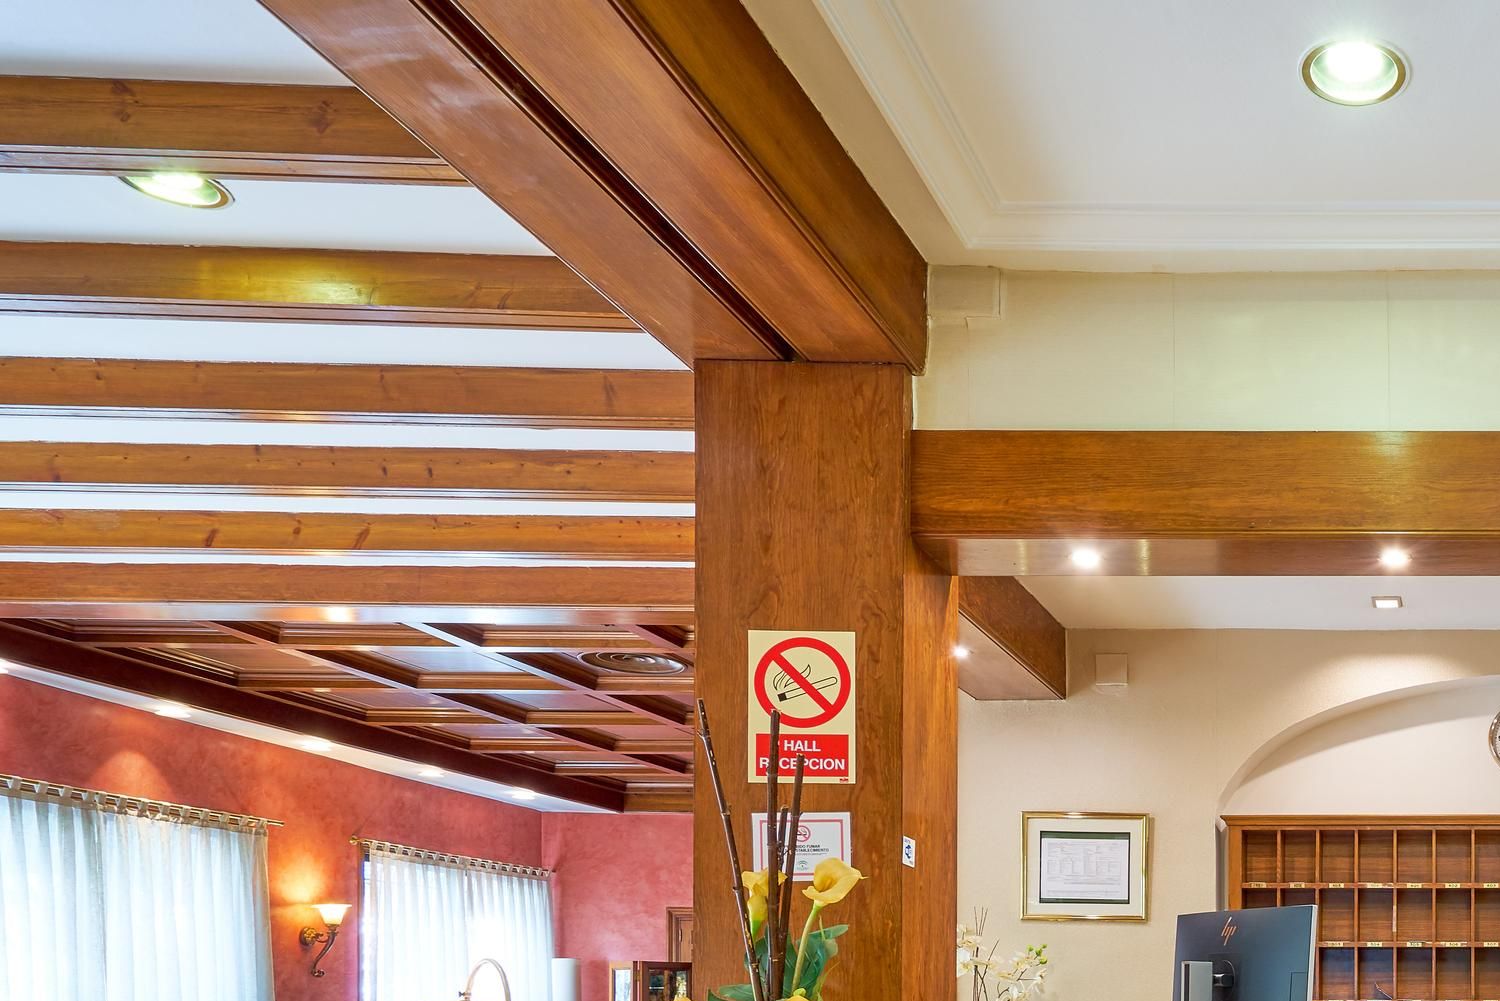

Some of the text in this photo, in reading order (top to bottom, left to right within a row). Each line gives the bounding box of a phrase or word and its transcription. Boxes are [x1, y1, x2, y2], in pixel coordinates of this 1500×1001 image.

[784, 740, 821, 752] HALL
[759, 757, 845, 770] RCEPCION
[1221, 916, 1236, 946] hp
